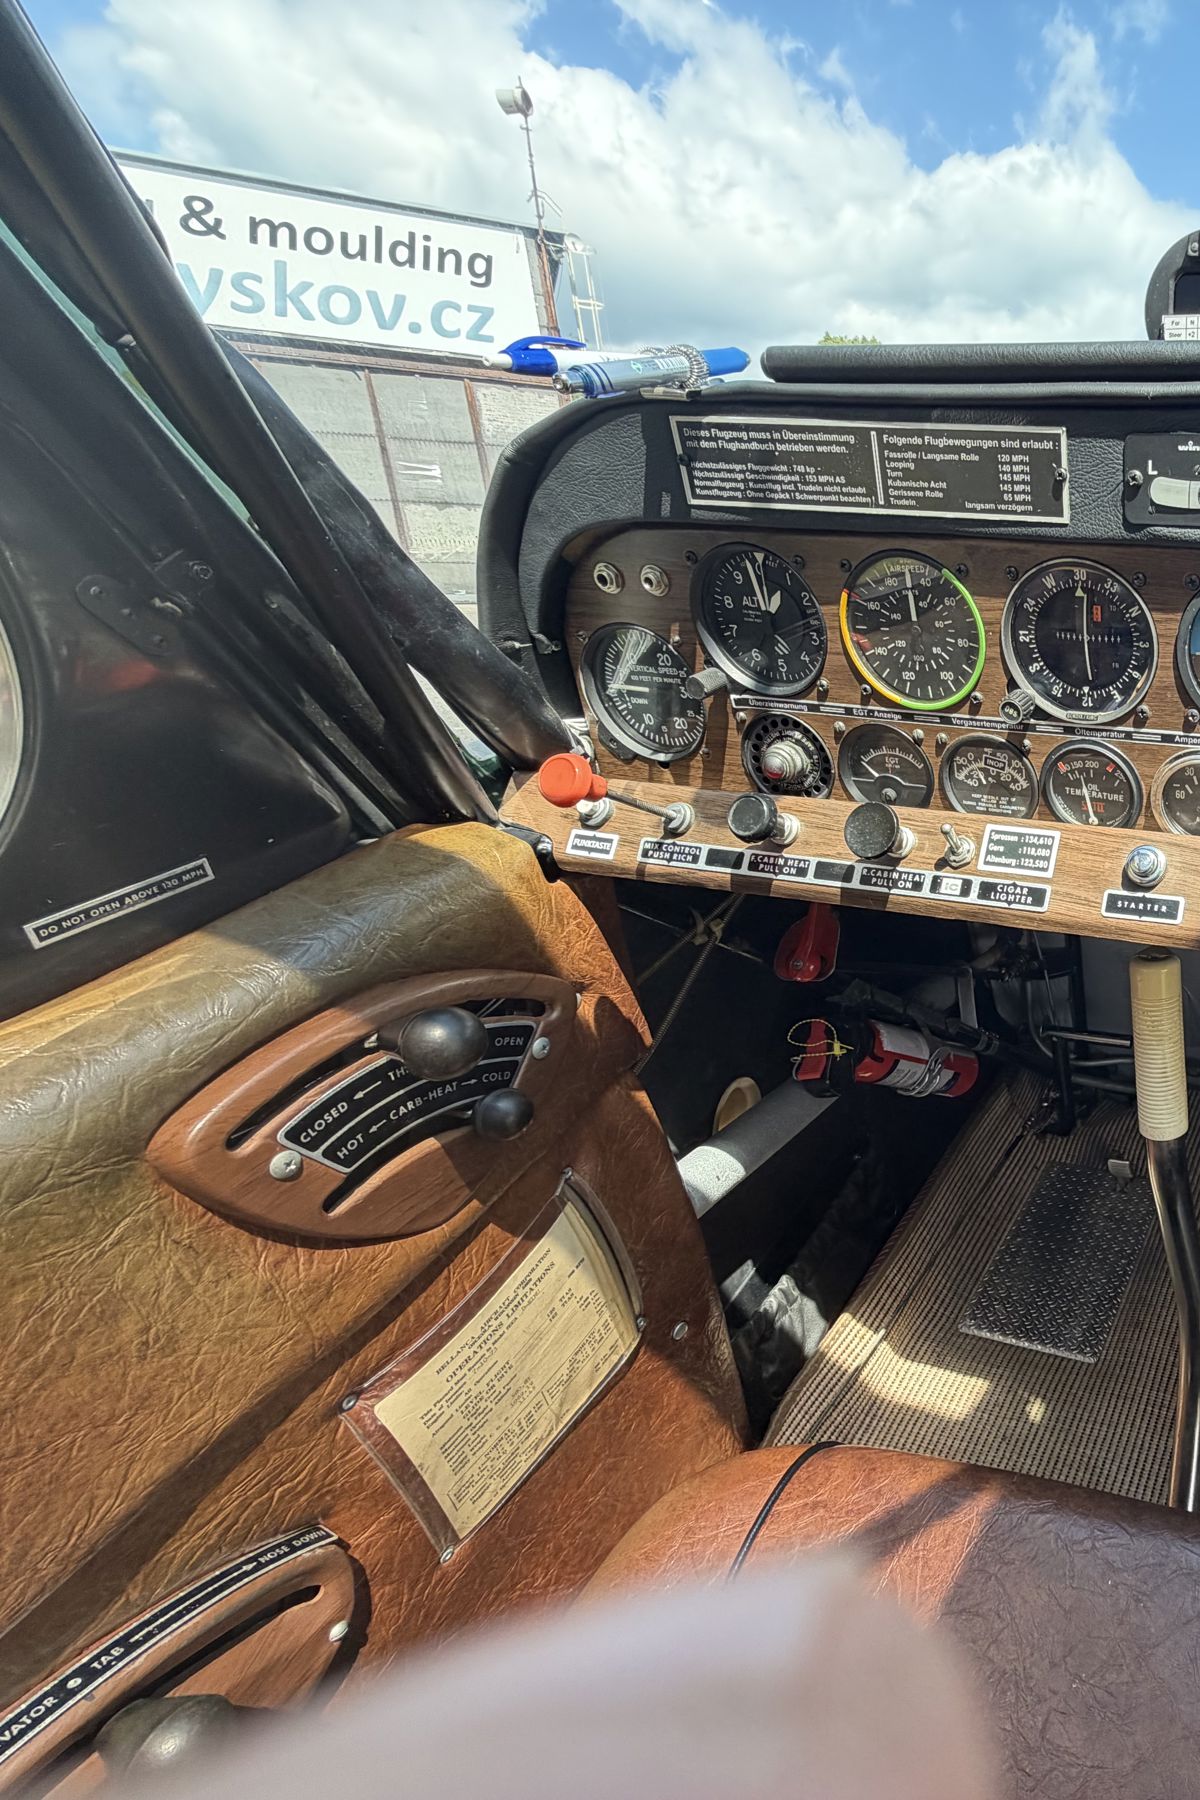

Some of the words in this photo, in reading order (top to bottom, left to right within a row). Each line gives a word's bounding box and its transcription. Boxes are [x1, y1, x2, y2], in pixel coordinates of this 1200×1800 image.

[179, 195, 226, 241] &
[249, 216, 494, 288] moulding
[176, 259, 495, 344] yskov.cz
[684, 428, 710, 437] Dieses
[712, 429, 747, 440] Flugzeug
[749, 431, 771, 439] muss
[772, 431, 781, 439] in
[783, 429, 854, 444] Übereinstimmung
[883, 435, 922, 445] Folgende
[925, 436, 998, 449] Flugbewegungen
[1001, 439, 1020, 449] sind
[686, 440, 698, 448] mit
[700, 440, 716, 448] dem
[719, 441, 774, 451] Flughandbuch
[777, 443, 814, 452] betrieben
[816, 445, 848, 453] werden.
[885, 451, 916, 460] Fassrolle
[923, 452, 959, 462] Langsame
[961, 453, 979, 461] Rolle
[1012, 455, 1029, 463] MPH
[885, 461, 914, 470] Looping
[1013, 465, 1029, 473] MPH
[1148, 460, 1158, 475] L
[1013, 474, 1030, 482] MPH
[888, 479, 928, 488] Kubanische
[930, 481, 946, 489] Acht
[1000, 484, 1011, 492] 145
[889, 489, 923, 497] Gerissene
[925, 490, 943, 498] Rolle
[965, 501, 995, 511] langsam
[997, 503, 1032, 512] verzögern
[742, 596, 759, 607] ALT
[853, 708, 868, 716] EGT
[874, 711, 902, 720] Anzeige
[951, 718, 1024, 730] Vergasertemperatur
[1075, 727, 1125, 739] Öltemperatur
[987, 759, 1005, 768] INOP
[1065, 787, 1124, 802] TEMPERATURE
[572, 838, 612, 850] FUNKTASTE
[644, 842, 660, 851] MIX
[663, 843, 701, 856] CONTROL
[648, 850, 670, 860] PUSH
[673, 853, 692, 862] RICH
[751, 855, 784, 866] F.CABIN
[787, 859, 809, 869] HEAT
[759, 864, 780, 872] PULL
[783, 866, 796, 875] ON
[863, 868, 898, 880] R.CABIN
[901, 873, 925, 883] HEAT
[872, 877, 893, 887] PULL
[898, 880, 912, 889] ON
[997, 884, 1028, 895] CIGAR
[39, 926, 58, 937] DO
[62, 914, 86, 929] NOT
[90, 900, 120, 918] OPEN
[125, 886, 160, 905] ABOVE
[182, 868, 204, 882] MPH
[991, 891, 1032, 905] LIGHTER
[1117, 900, 1168, 913] STARTER
[494, 1037, 524, 1046] OPEN
[336, 1133, 364, 1160] HOT
[390, 1081, 458, 1121] CARB-HEAT
[482, 1070, 511, 1083] COLD
[300, 1101, 348, 1144] CLOSED
[446, 1321, 504, 1383] OPERATIONS
[506, 1261, 556, 1319] LIMITATIONS
[0, 1696, 58, 1747] VATOR
[91, 1646, 125, 1671] TAB
[258, 1544, 291, 1565] NOSE
[292, 1529, 326, 1548] DOWN
